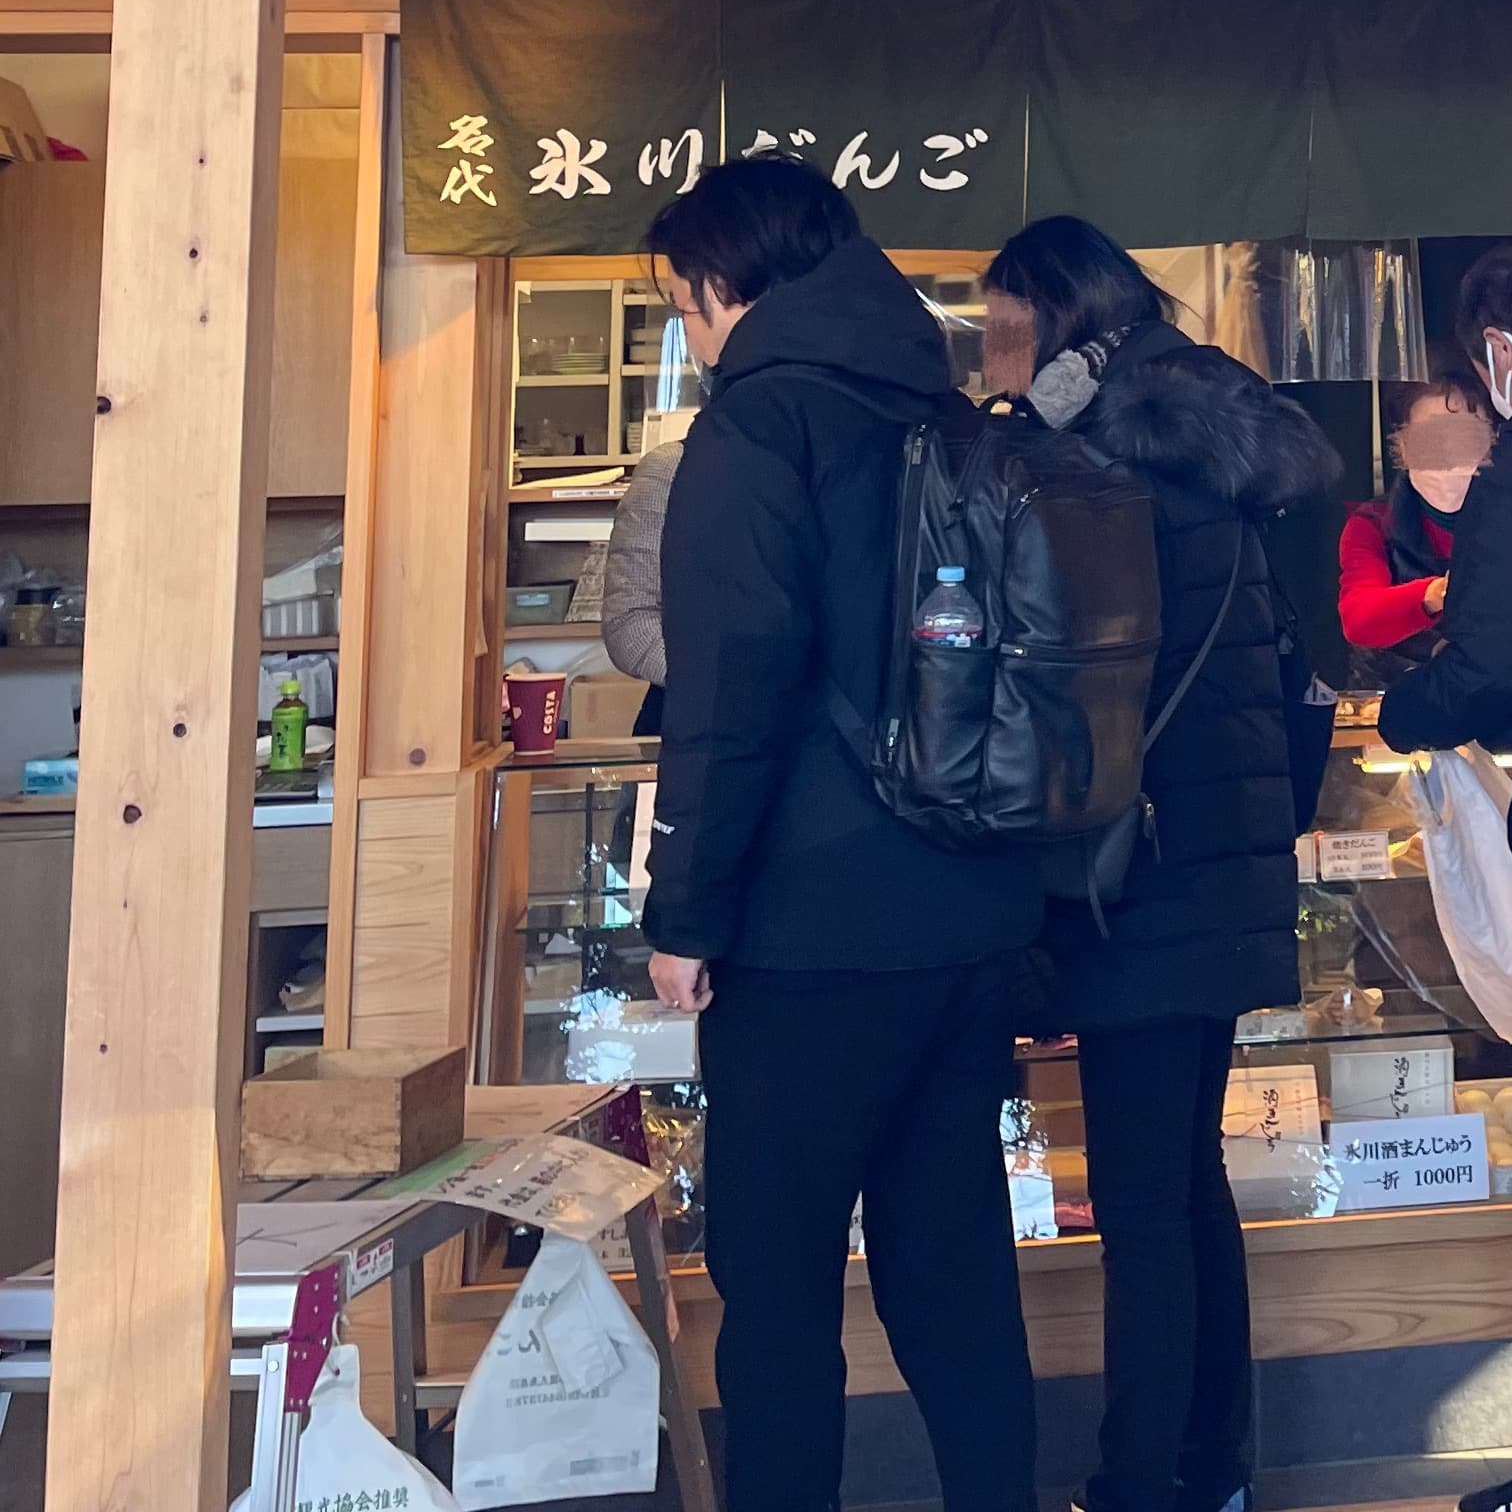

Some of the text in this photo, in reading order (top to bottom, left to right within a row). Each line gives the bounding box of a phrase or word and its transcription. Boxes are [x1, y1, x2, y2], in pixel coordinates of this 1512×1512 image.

[438, 114, 498, 206] 名代
[543, 690, 557, 735] COSTA
[1344, 1135, 1472, 1161] 氷川酒まんじゅう
[1363, 1165, 1473, 1190] 一折 1000円
